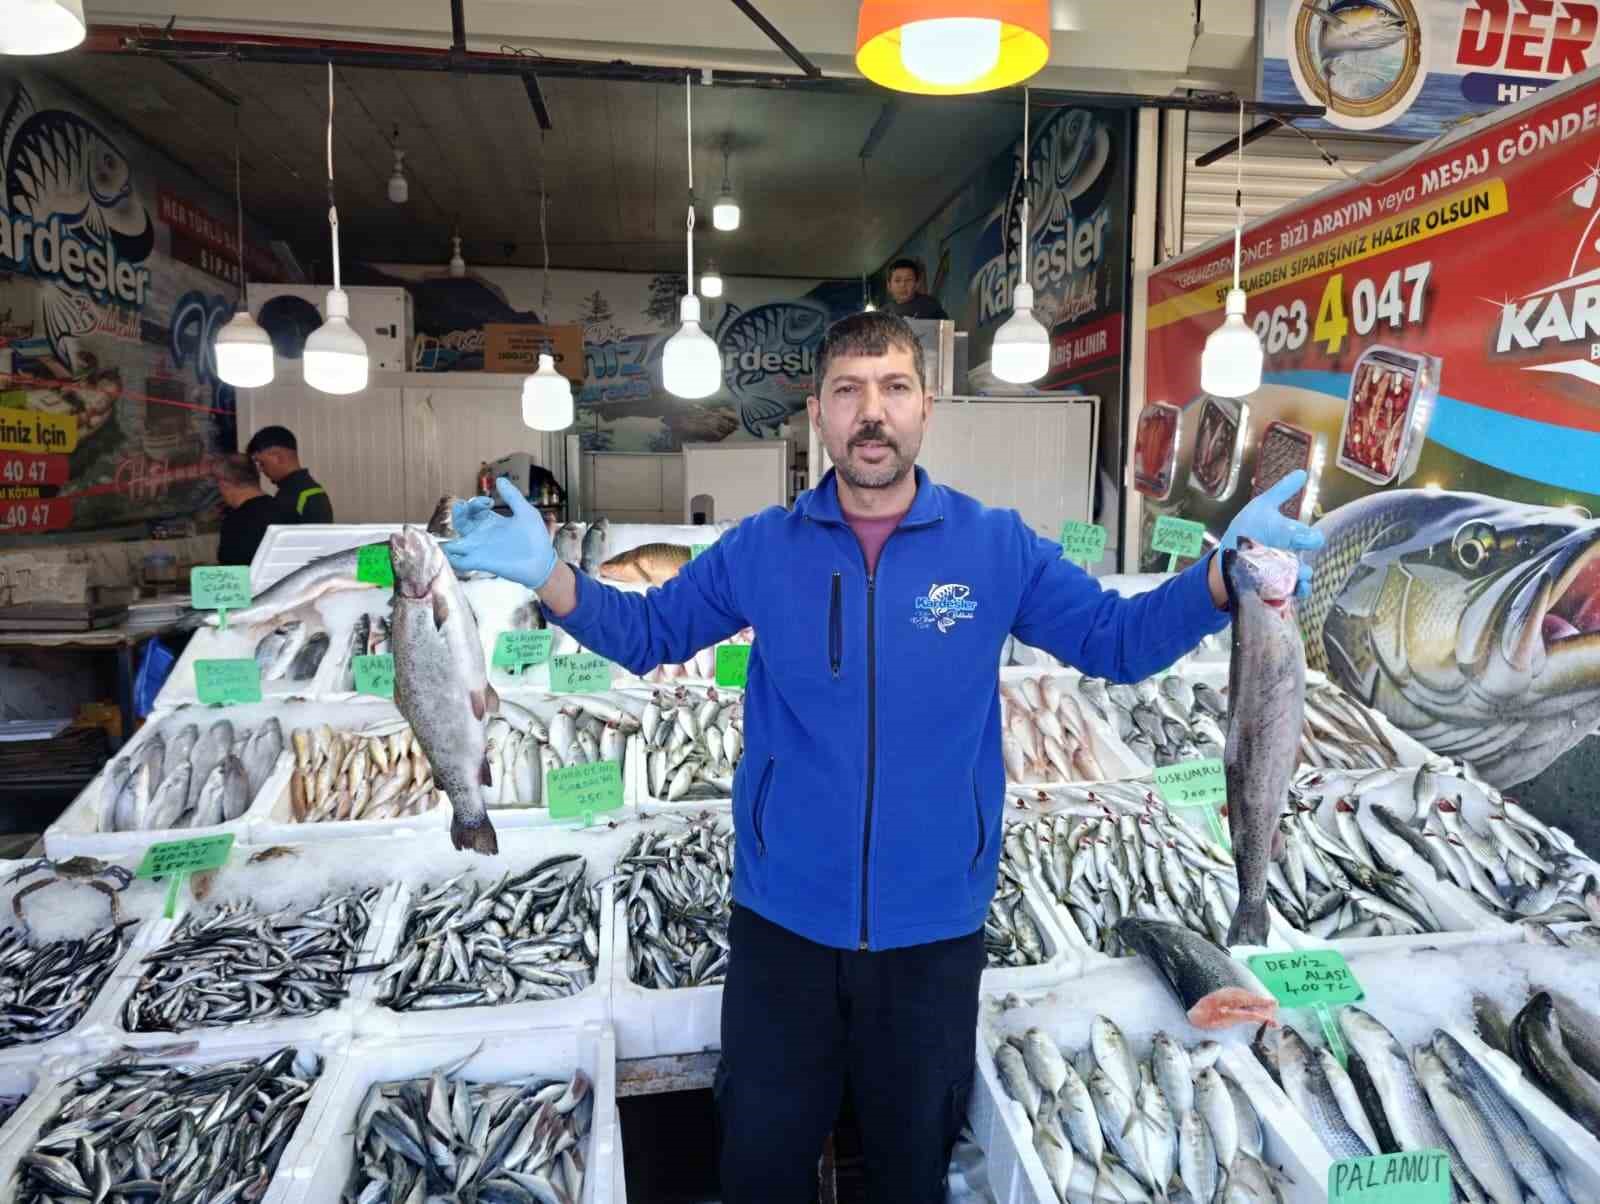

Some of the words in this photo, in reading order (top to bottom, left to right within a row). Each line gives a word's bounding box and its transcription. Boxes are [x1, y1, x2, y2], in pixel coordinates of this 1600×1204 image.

[1456, 0, 1598, 74] DER
[1312, 197, 1373, 240] ARAYIN
[1377, 187, 1416, 213] veya
[1421, 148, 1490, 196] MESAJ
[1498, 104, 1600, 165] GÖNDE
[1242, 268, 1287, 295] ELMEDEN
[1371, 215, 1421, 250] HAZIR
[1425, 192, 1489, 230] OLSUN
[1313, 273, 1348, 354] 4
[1352, 261, 1431, 335] 047
[36, 416, 67, 450] İçin
[4, 461, 24, 481] 40
[28, 461, 48, 480] 47
[1158, 764, 1221, 785] USKUMRU
[1265, 955, 1327, 972] DENİZ
[1286, 981, 1320, 995] 400
[1325, 982, 1351, 991] TL
[1335, 1154, 1448, 1197] PALAMUT
